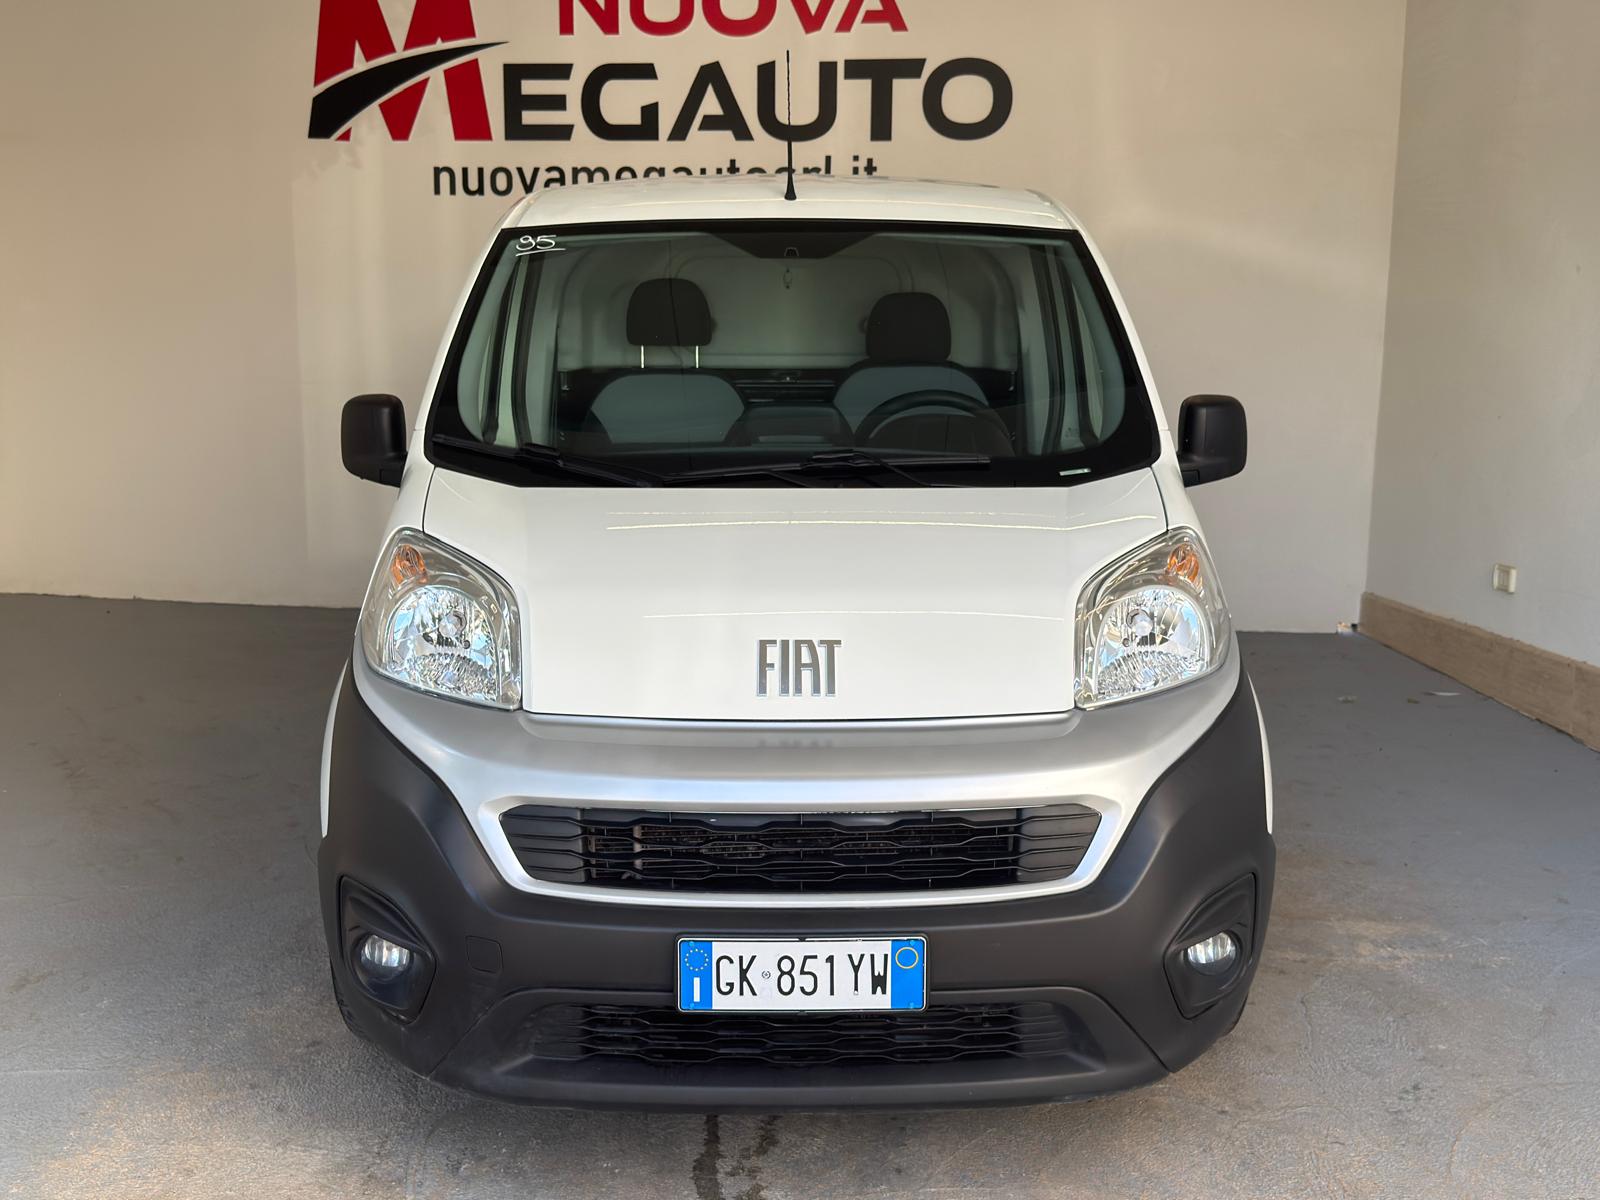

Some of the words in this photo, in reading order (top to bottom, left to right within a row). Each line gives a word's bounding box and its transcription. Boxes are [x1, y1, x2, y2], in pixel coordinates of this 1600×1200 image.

[515, 234, 557, 251] 95
[756, 639, 842, 697] FIAT
[715, 954, 758, 997] GK
